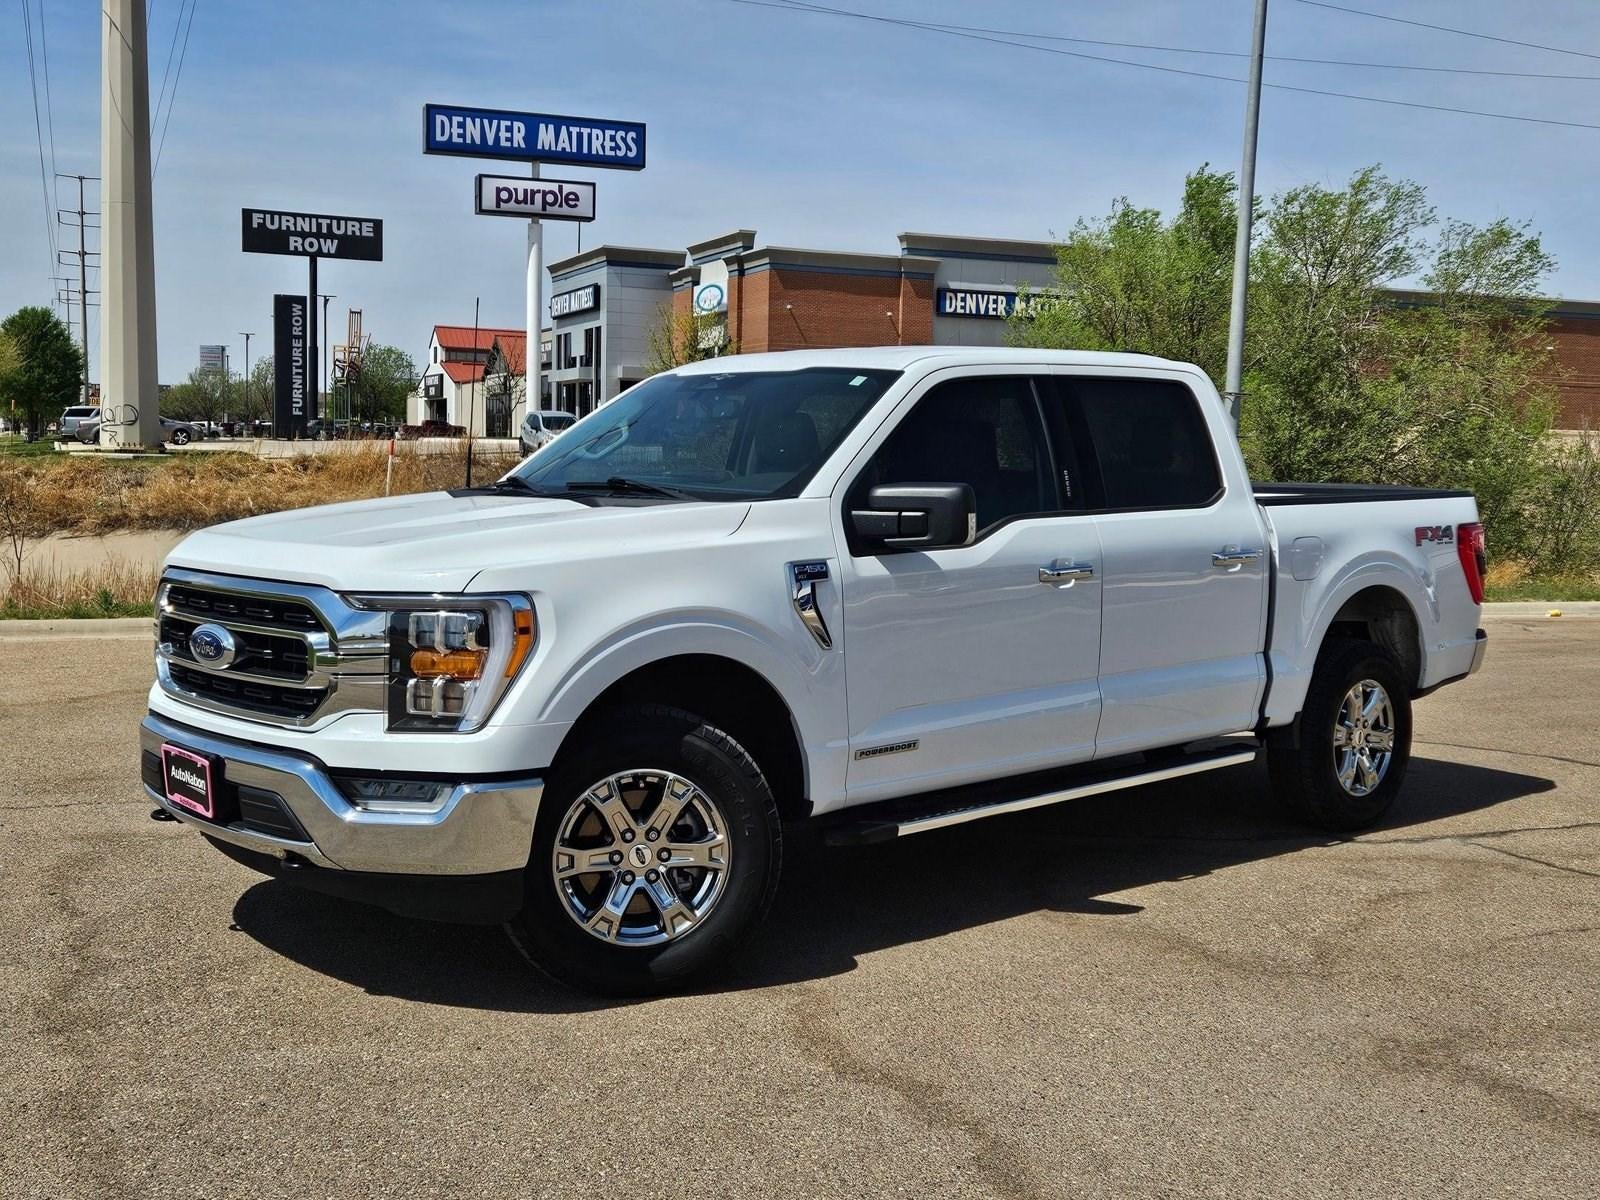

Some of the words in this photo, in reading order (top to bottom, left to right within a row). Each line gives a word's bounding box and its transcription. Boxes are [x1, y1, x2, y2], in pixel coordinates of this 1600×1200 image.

[435, 114, 526, 148] DENVER
[537, 123, 638, 158] MATTRESS
[495, 184, 580, 212] purple
[252, 212, 374, 237] FURNITURE
[289, 236, 338, 254] ROW
[945, 292, 1006, 316] DENVER
[292, 303, 303, 335] ROW
[292, 338, 303, 415] FURNITURE
[1415, 525, 1454, 546] FX4
[859, 742, 917, 757] POWERBOOST
[171, 765, 206, 790] AutoNation
